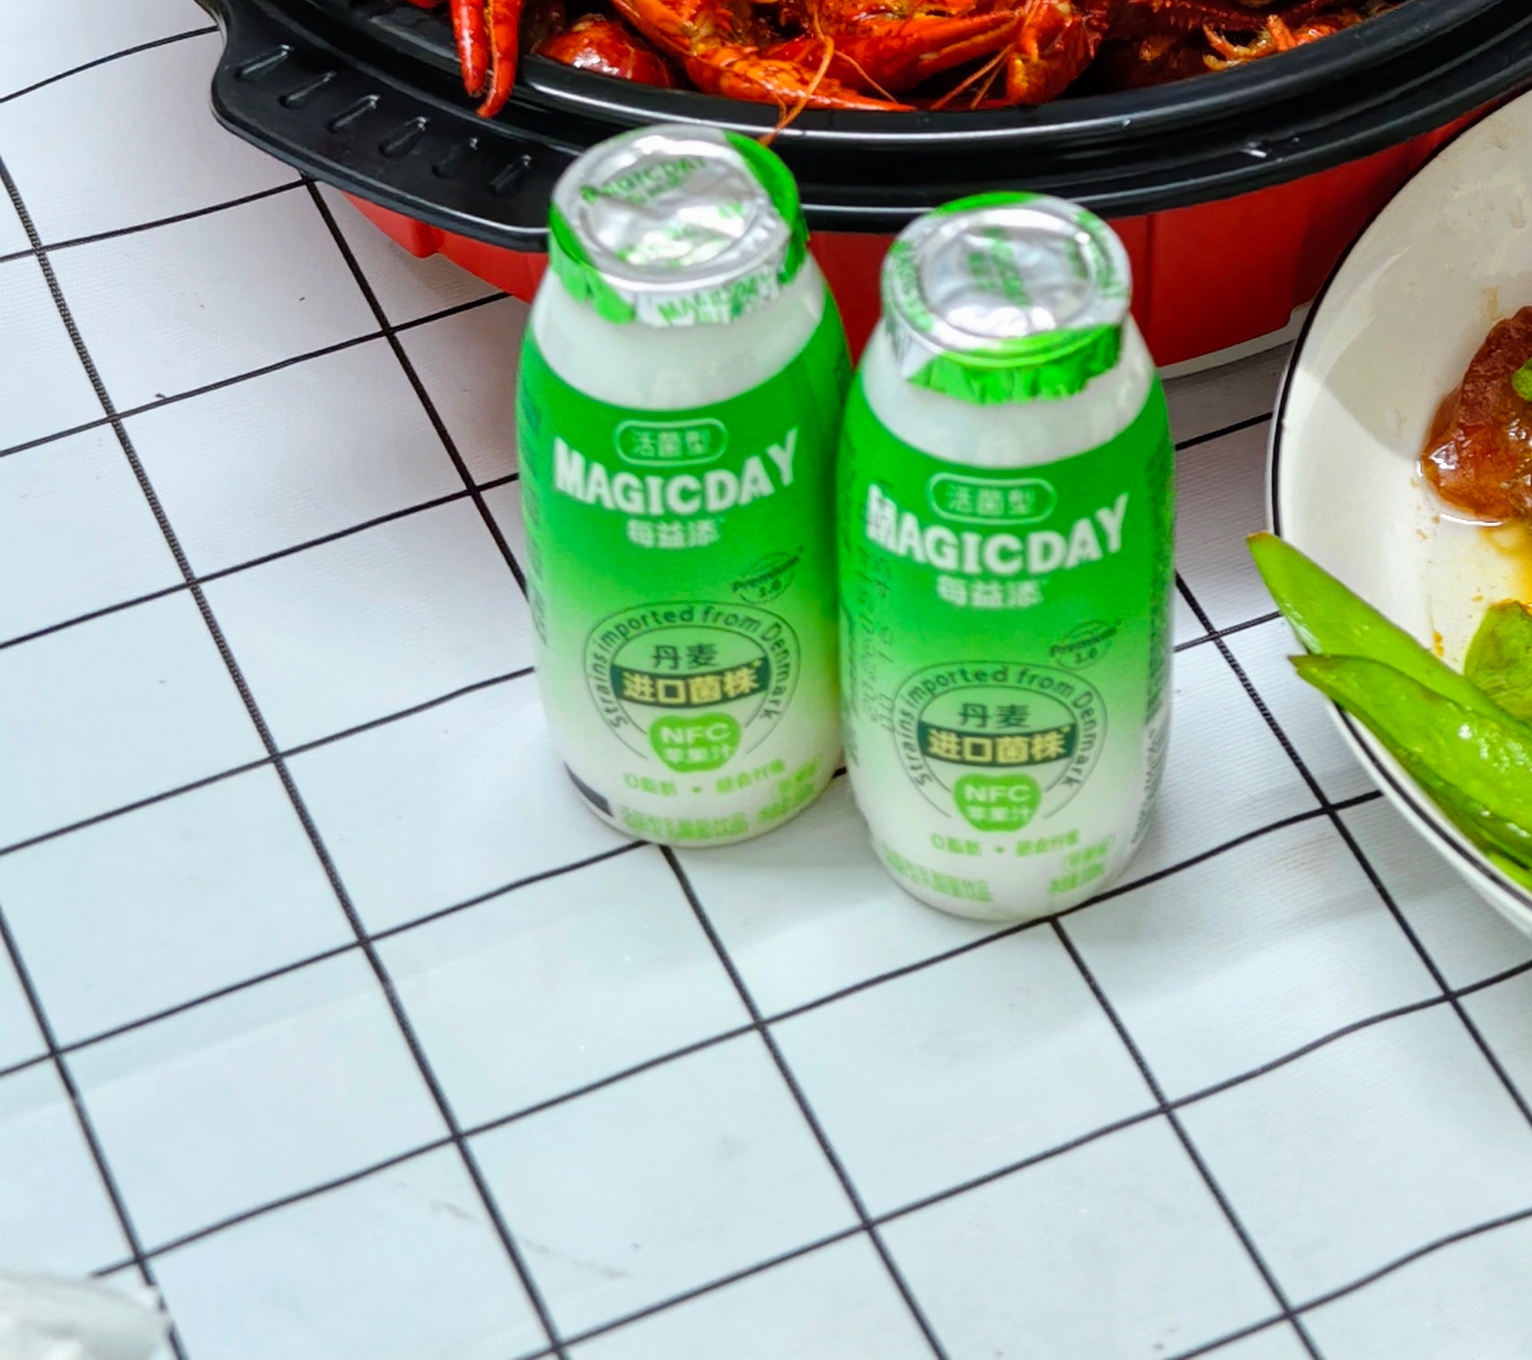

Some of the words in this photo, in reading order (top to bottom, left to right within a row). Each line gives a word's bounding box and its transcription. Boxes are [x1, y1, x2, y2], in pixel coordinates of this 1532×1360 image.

[553, 427, 799, 516] MAGICDAY
[865, 483, 1130, 576] MAGICDAY
[592, 605, 695, 652] imported
[701, 606, 761, 631] from
[651, 643, 719, 669] 丹麦
[761, 622, 792, 720] Denmark
[590, 652, 629, 729] Strains
[622, 667, 760, 704] 进口菌株
[907, 666, 1010, 709] imported
[1017, 668, 1075, 698] from
[661, 722, 731, 744] NFC
[957, 702, 1030, 728] 丹麦
[897, 710, 933, 787] Strains
[928, 728, 1066, 764] 进口菌株
[1072, 691, 1098, 787] Denmark
[965, 784, 1032, 802] NFC
